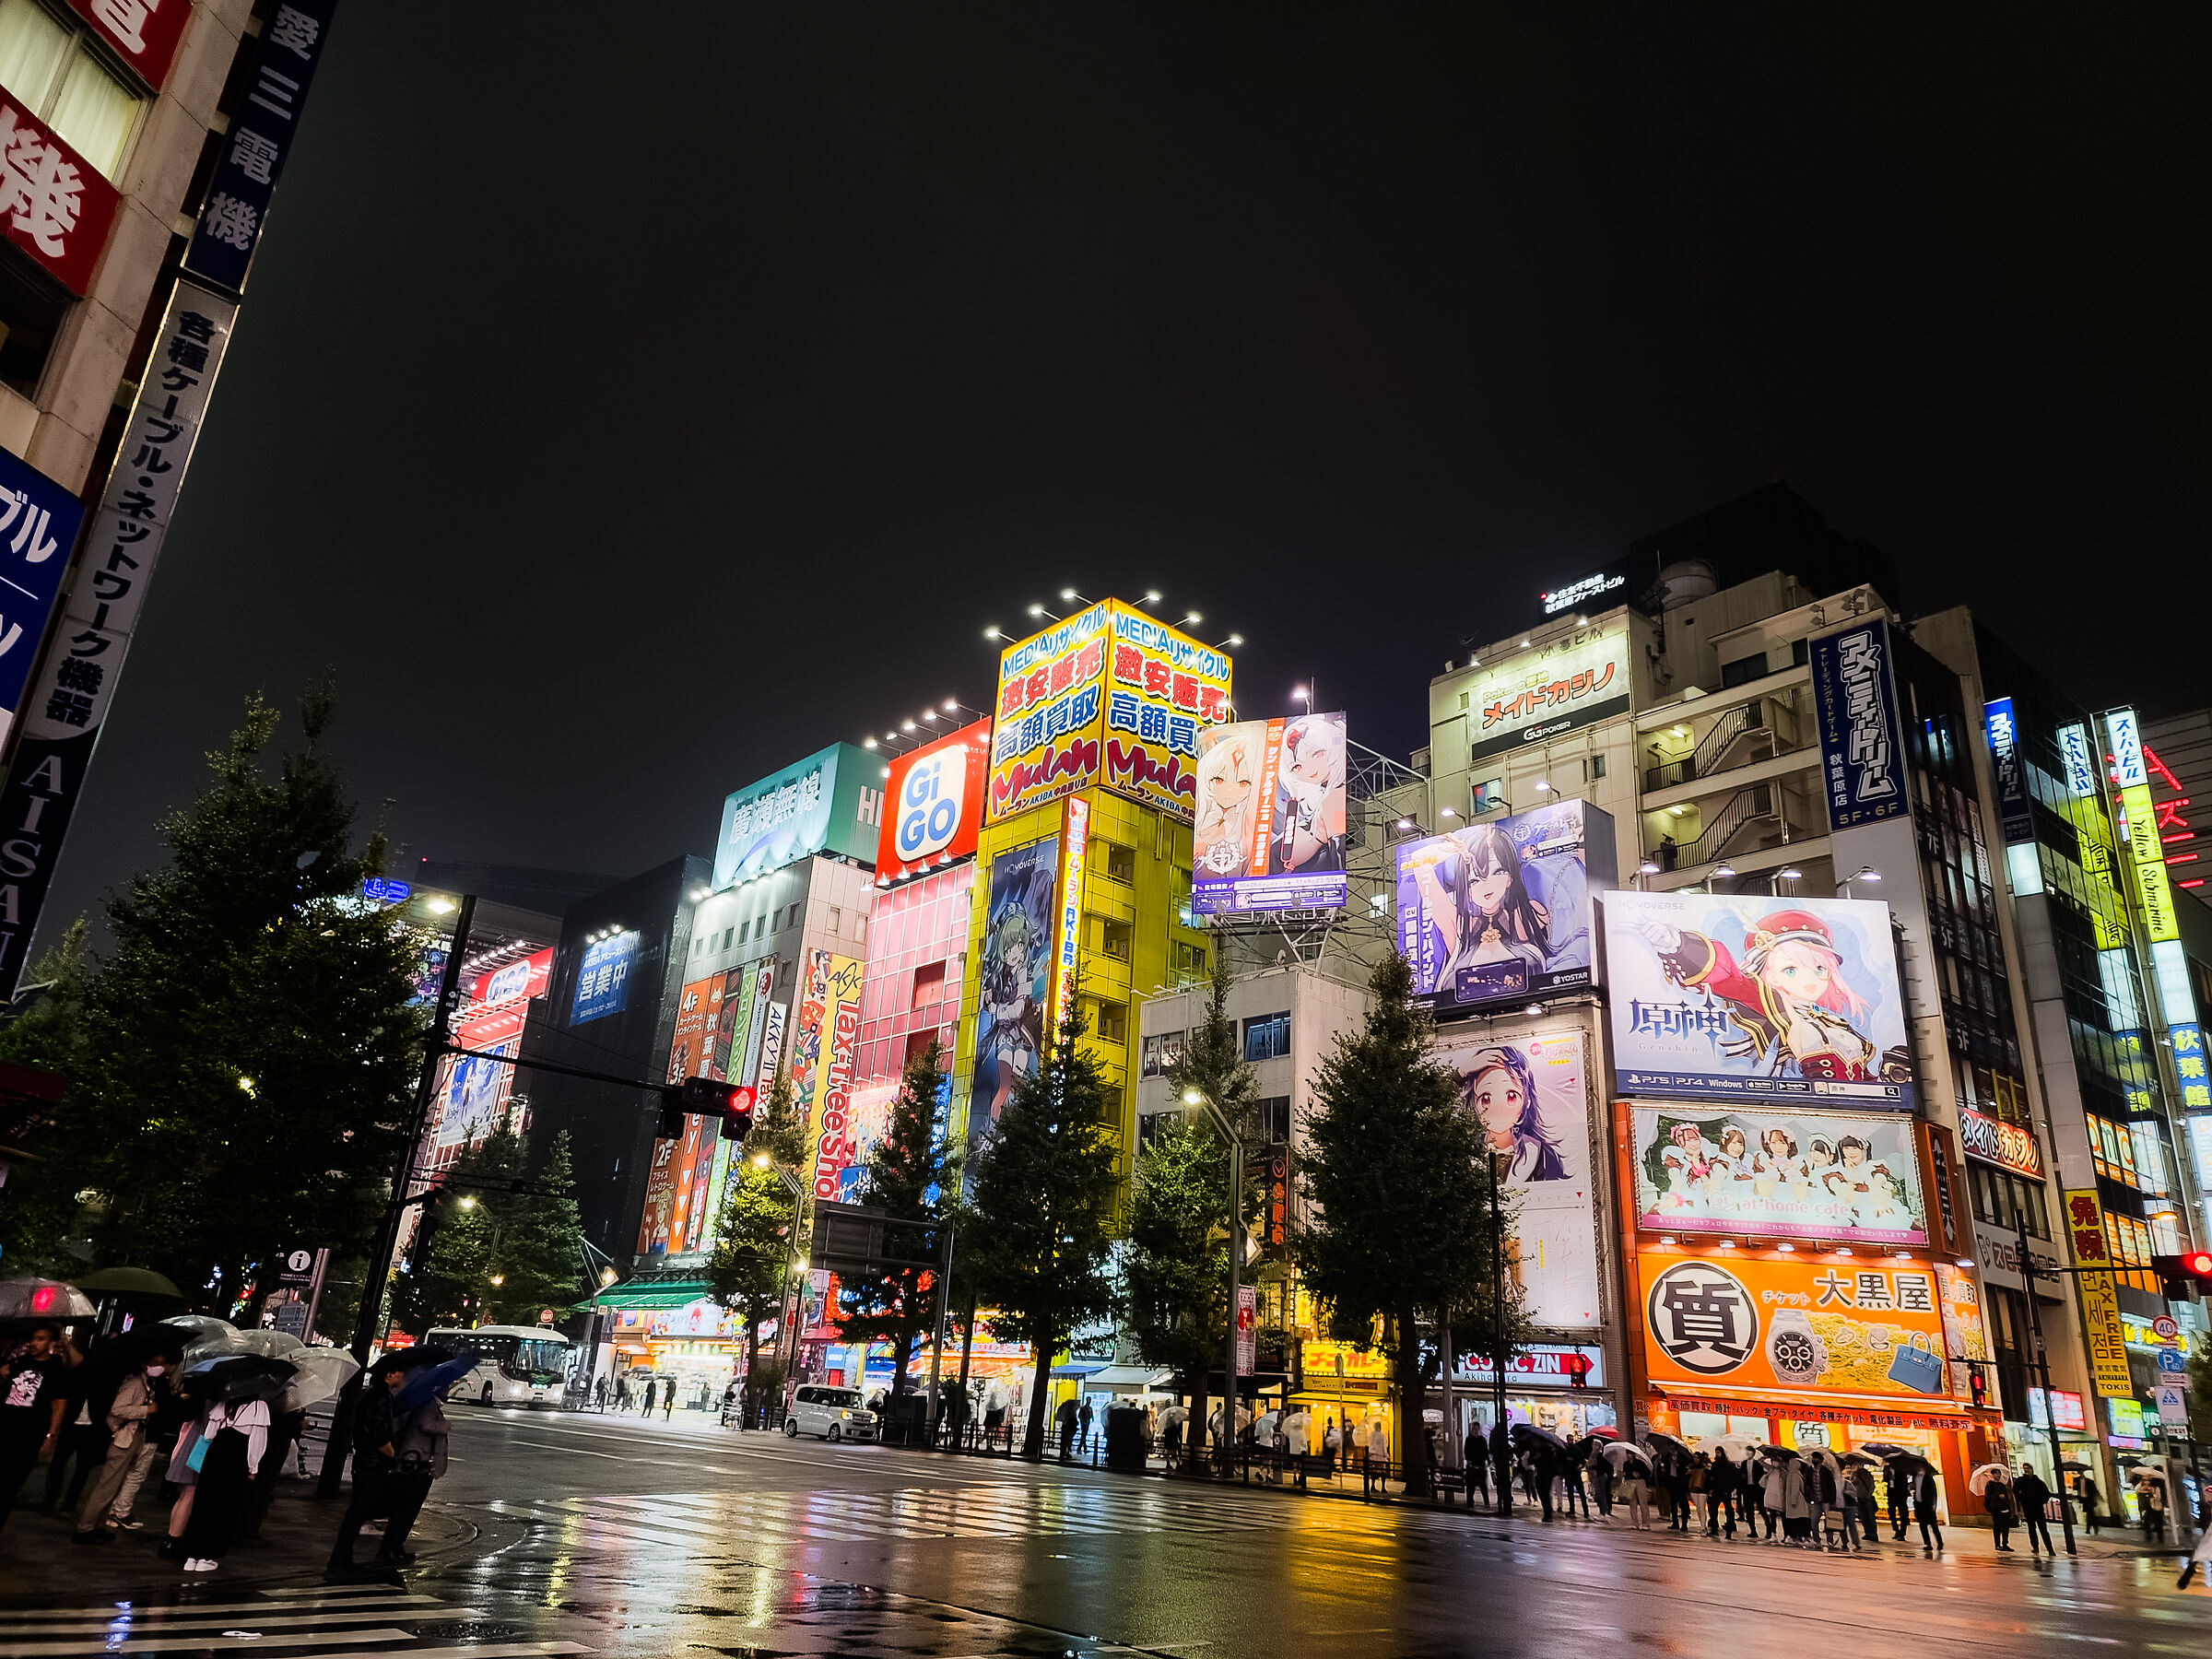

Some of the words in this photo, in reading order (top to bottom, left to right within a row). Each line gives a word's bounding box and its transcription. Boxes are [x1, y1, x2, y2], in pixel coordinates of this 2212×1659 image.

[205, 5, 319, 251] 愛三電機
[45, 310, 216, 729] 各種ケーブル・ネットワーク機器
[1003, 605, 1107, 681] MEDIAリサイクル
[1113, 612, 1230, 681] MEDIAリサイクル
[1000, 638, 1103, 721] 激安販売
[1114, 643, 1225, 722] 激安販売
[1482, 662, 1615, 730] メイドカジノ
[996, 683, 1100, 766] 高額買取
[1109, 692, 1197, 756] 高額買
[2115, 718, 2140, 780] スーパービル
[905, 760, 941, 808] Gi
[993, 738, 1099, 817] Mulan
[1107, 739, 1196, 804] Mula
[1830, 753, 1848, 807] 秋葉原店
[900, 798, 956, 851] GO
[2132, 818, 2150, 859] Yellow
[0, 754, 63, 971] AISA
[2141, 869, 2165, 935] Submarine
[579, 959, 629, 1003] 営業中
[682, 990, 699, 1013] 4F
[1560, 971, 1588, 982] YOSTAR
[699, 1013, 718, 1078] 秋葉原
[728, 978, 751, 1082] メロンブック
[766, 1006, 782, 1061] AKKY
[1630, 988, 1729, 1053] 原神
[1639, 1042, 1700, 1053] Genshin
[669, 1062, 686, 1085] 3F
[1641, 1077, 1670, 1085] PS5
[1676, 1077, 1705, 1086] PS4
[1708, 1079, 1744, 1089] Windows
[2172, 1029, 2211, 1107] 秋葉館
[816, 1002, 865, 1199] Tax-freeSho
[654, 1144, 672, 1168] 2F
[1959, 1108, 2040, 1171] メイドカジノ
[2068, 1195, 2106, 1261] 免税
[1761, 1290, 1811, 1307] チケット
[1814, 1268, 1935, 1313] 大黒屋
[2099, 1271, 2115, 1304] AX
[1661, 1279, 1751, 1361] 質
[2103, 1310, 2124, 1359] FREE
[2159, 1323, 2173, 1334] 40
[1465, 1371, 1518, 1382] Akihara
[1532, 1354, 1560, 1374] ZIN
[2098, 1373, 2129, 1382] AKIHABARA
[2100, 1382, 2130, 1392] TOKIS
[1669, 1398, 1712, 1412] 高価買取
[1929, 1418, 1971, 1430] 無料査定
